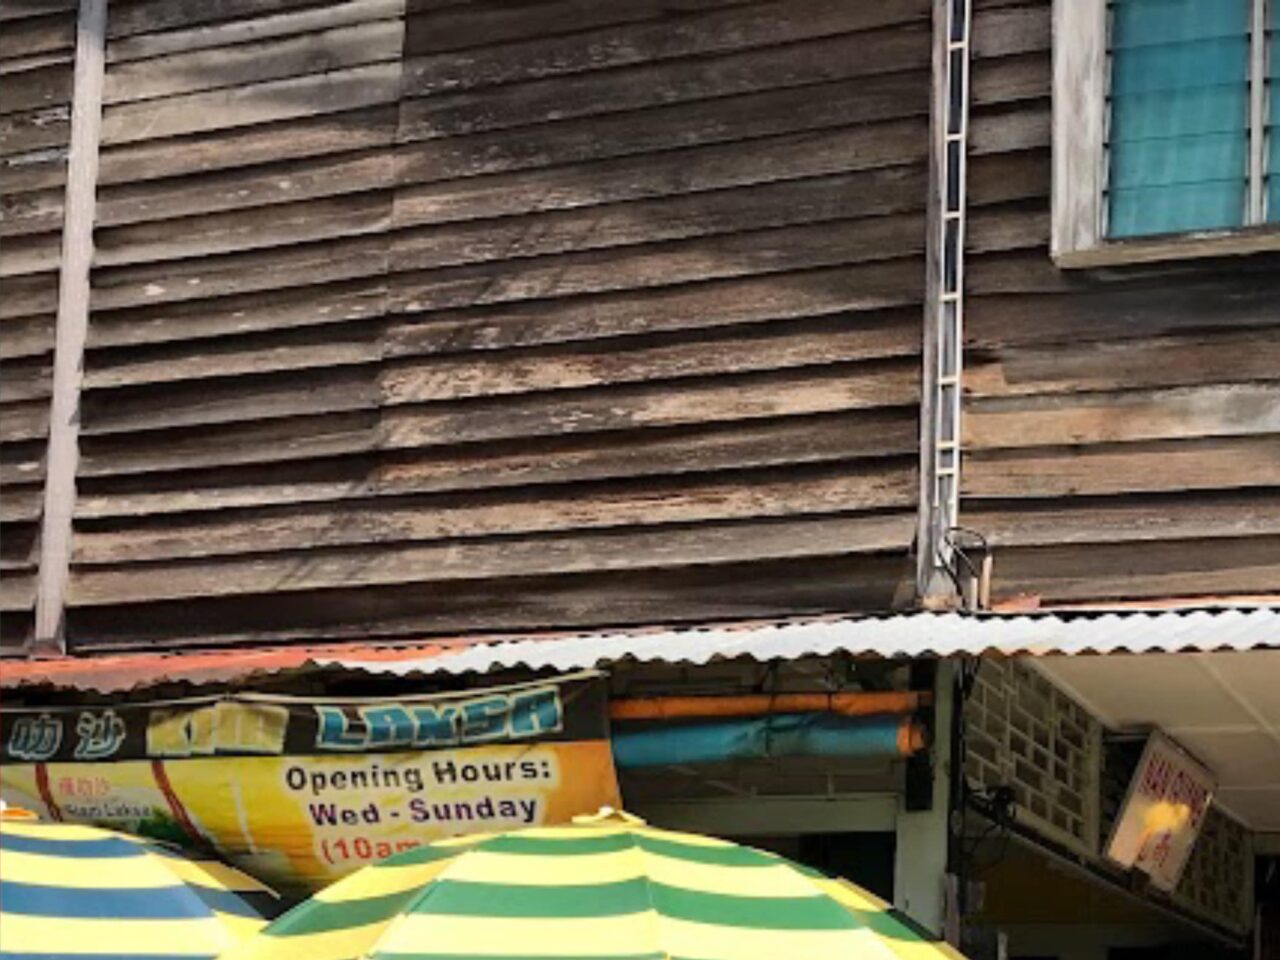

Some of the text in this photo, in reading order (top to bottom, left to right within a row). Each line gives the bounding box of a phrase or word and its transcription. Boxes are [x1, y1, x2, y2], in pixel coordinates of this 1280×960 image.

[313, 686, 563, 750] LAKSA
[286, 760, 551, 795] Opening Hours:
[309, 802, 381, 826] Wed
[409, 796, 537, 823] Sunday
